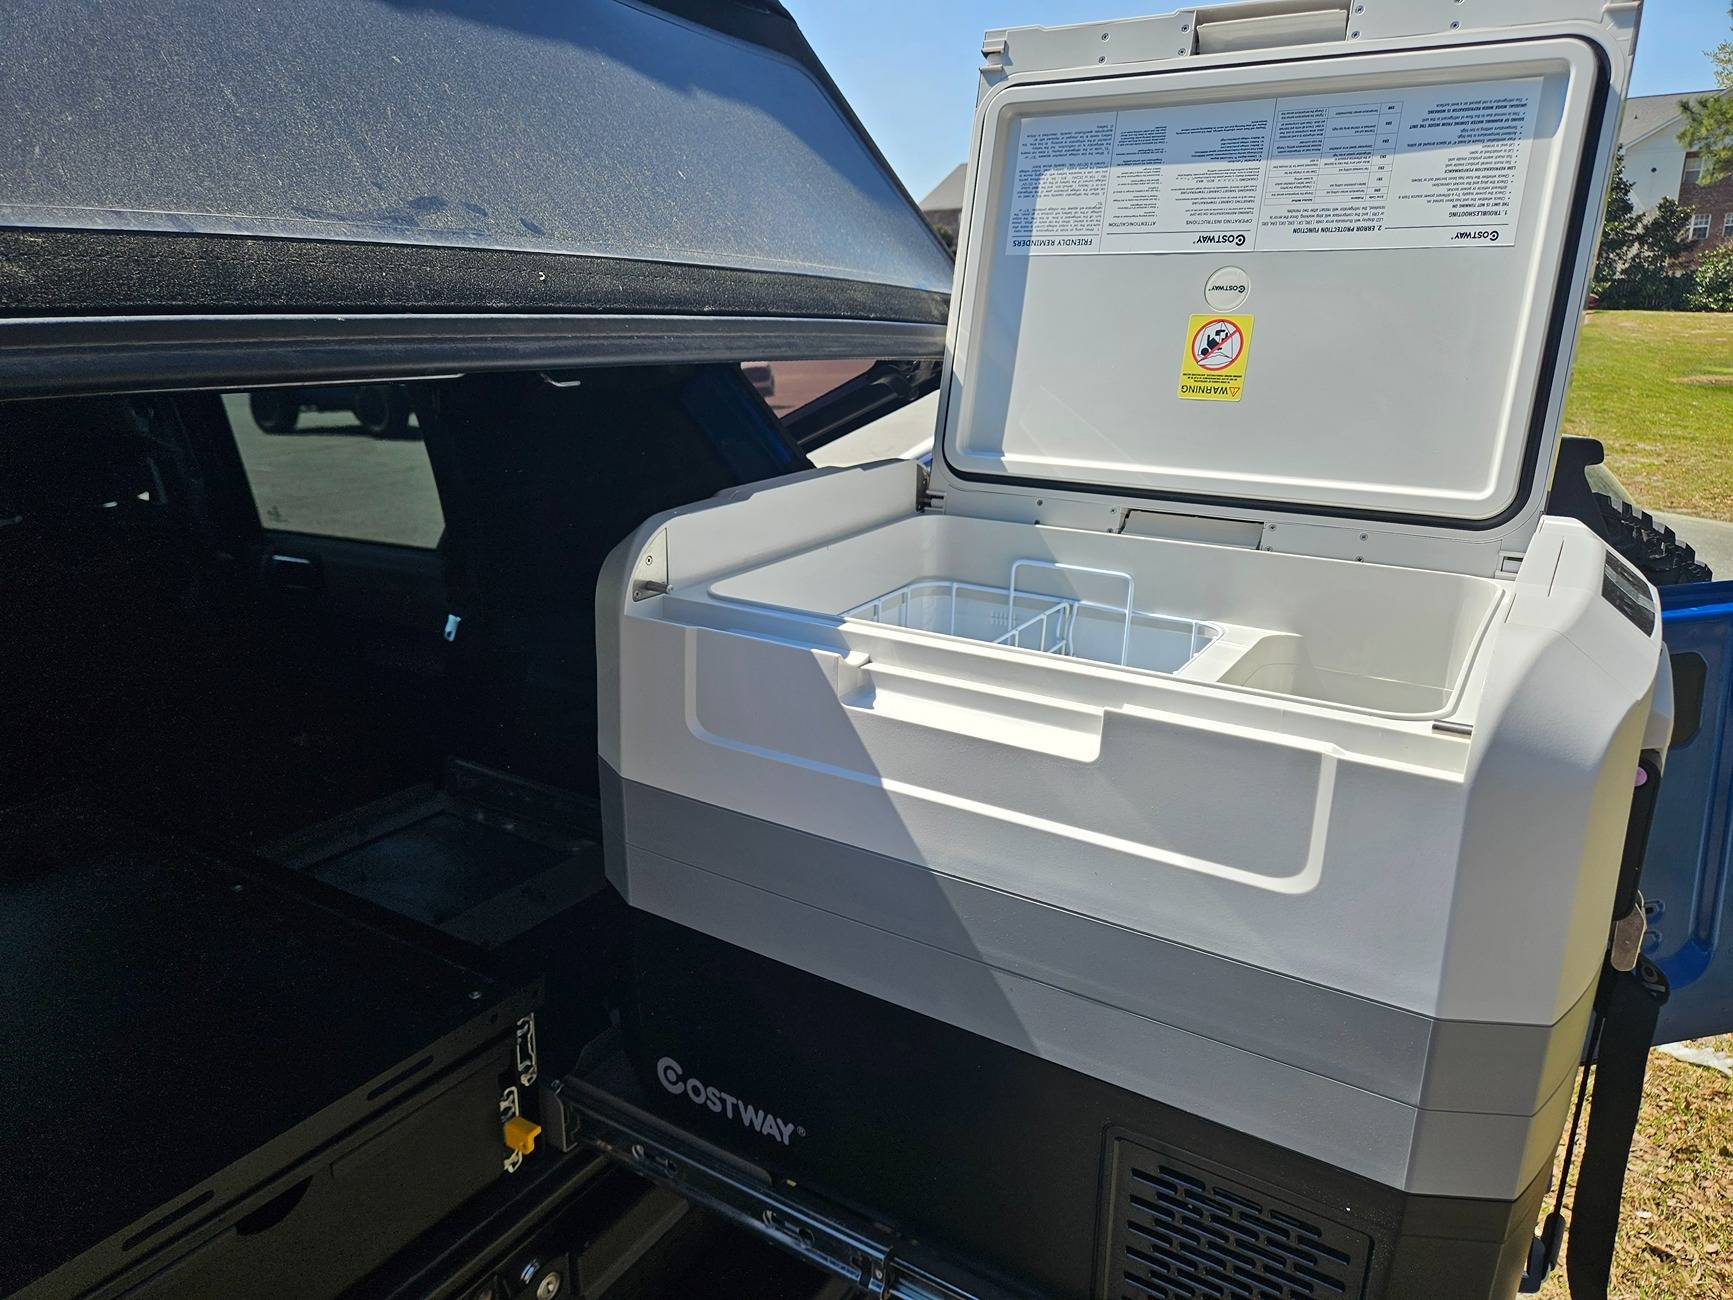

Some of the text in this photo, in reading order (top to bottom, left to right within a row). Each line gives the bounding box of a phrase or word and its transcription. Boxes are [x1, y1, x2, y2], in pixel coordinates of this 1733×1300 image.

[1447, 209, 1501, 217] TROUBLESHOOTING
[1195, 234, 1246, 246] COSTWAY
[1452, 230, 1499, 241] COSTWAY
[1012, 238, 1092, 246] FRIENDLY REMINDERS
[1181, 385, 1229, 395] WARNING
